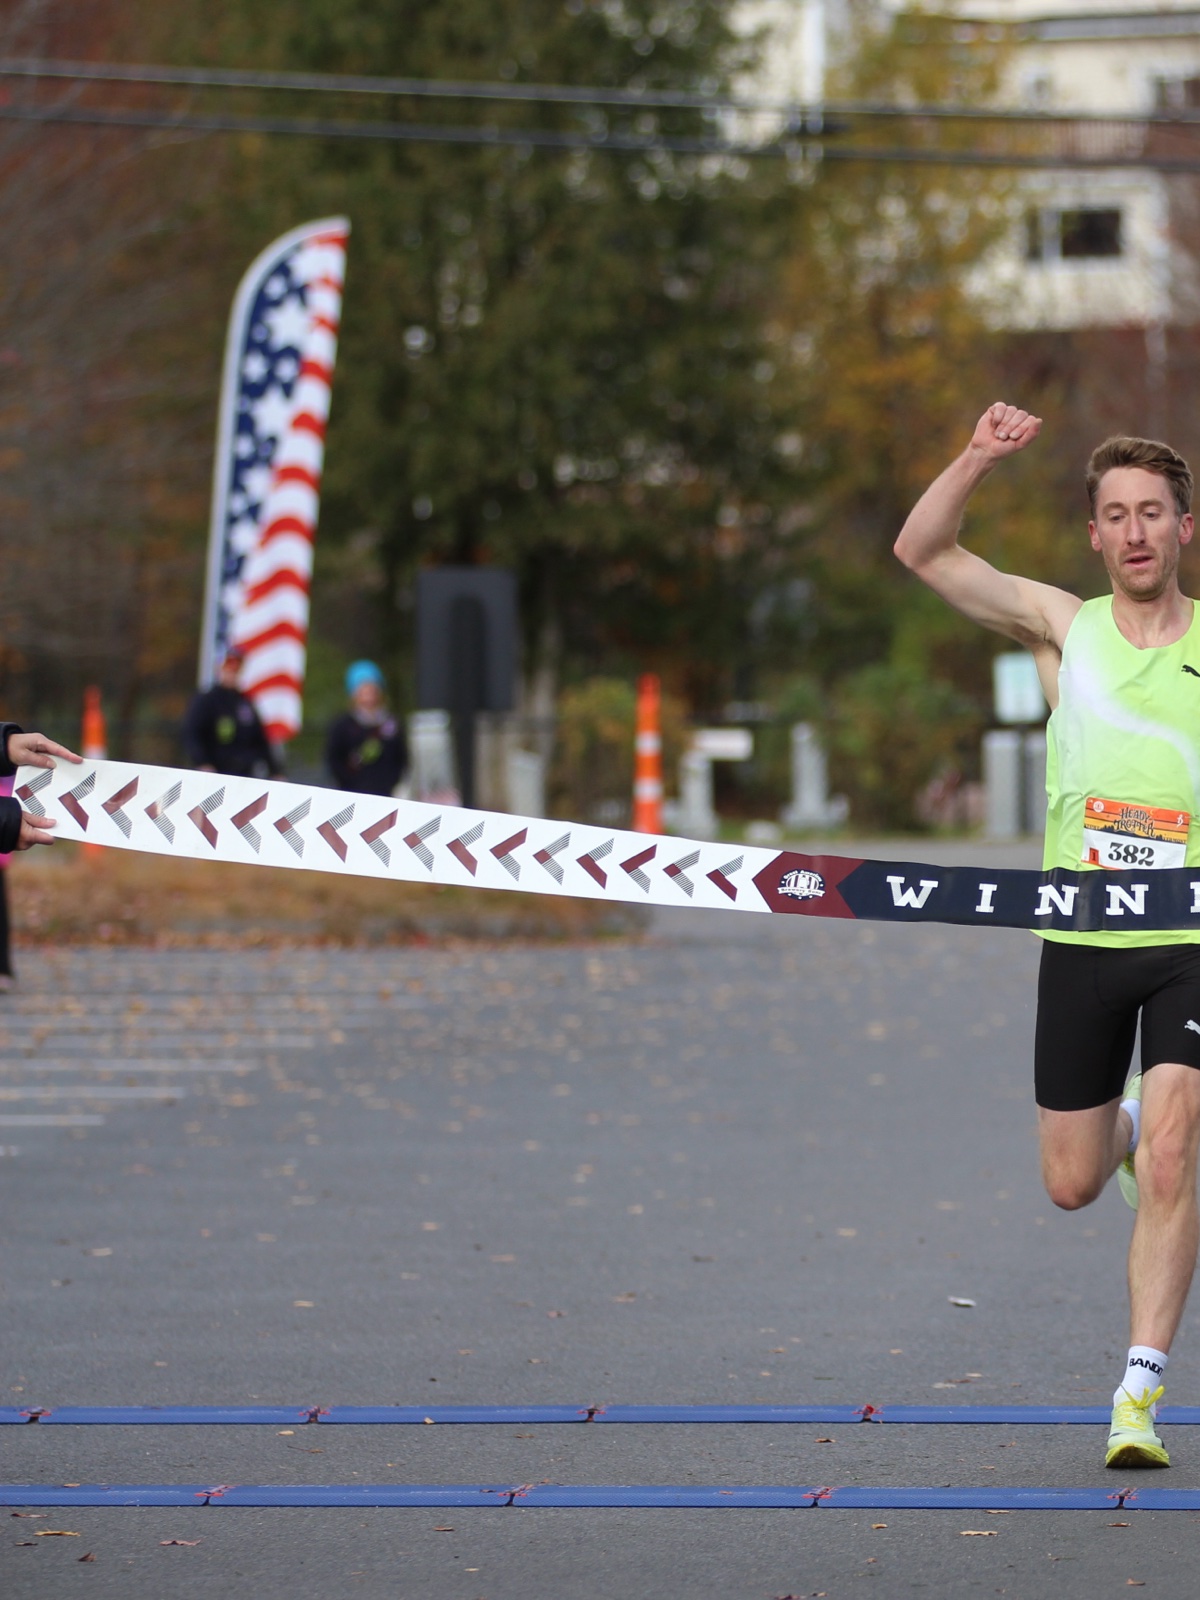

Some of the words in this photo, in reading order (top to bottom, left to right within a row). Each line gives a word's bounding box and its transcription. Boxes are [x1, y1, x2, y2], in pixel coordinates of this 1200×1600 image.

[1120, 806, 1150, 823] HEADY
[1114, 819, 1155, 838] TROTTER
[1108, 841, 1155, 867] 382
